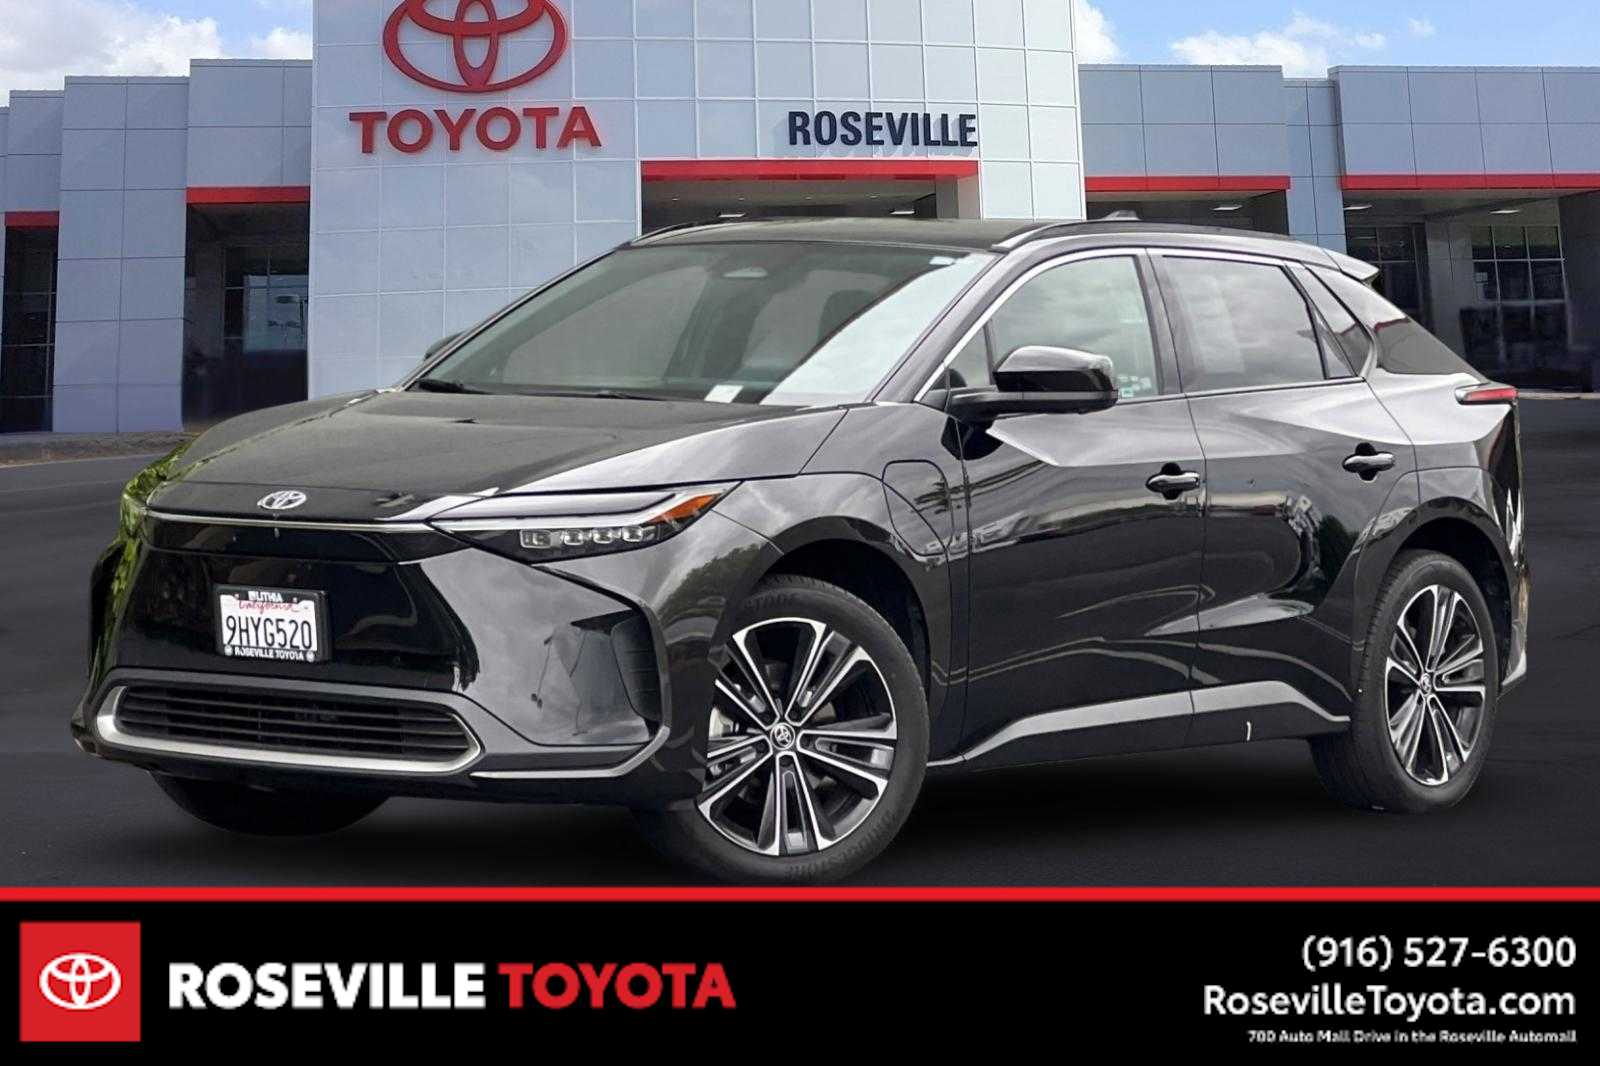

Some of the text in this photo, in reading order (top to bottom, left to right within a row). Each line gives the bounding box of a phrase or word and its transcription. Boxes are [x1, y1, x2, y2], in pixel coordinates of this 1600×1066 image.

[349, 106, 602, 154] TOYOTA
[788, 111, 978, 147] ROSEVILLE
[226, 615, 312, 649] 9HYG520
[234, 646, 304, 661] ROSEVILLE TOYOTA
